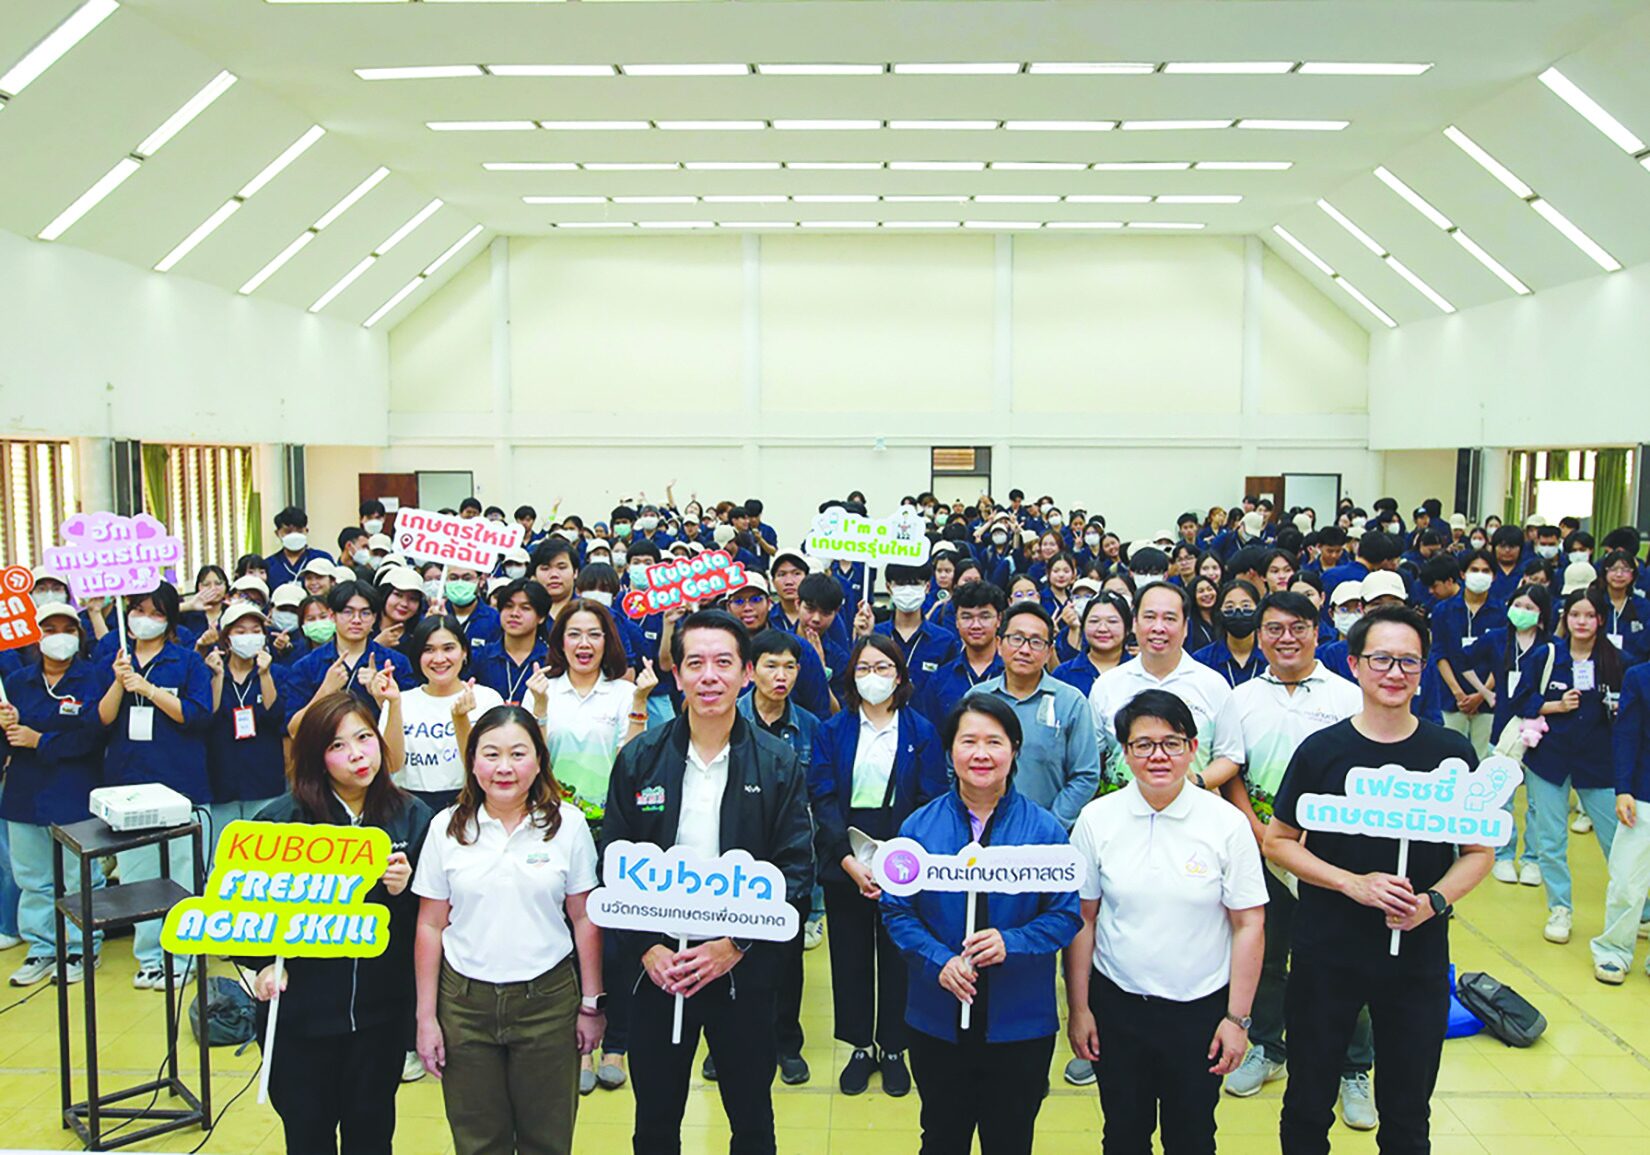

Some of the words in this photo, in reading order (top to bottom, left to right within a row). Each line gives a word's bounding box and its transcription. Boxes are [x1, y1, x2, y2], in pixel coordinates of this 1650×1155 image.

[401, 513, 518, 549] เกษตรใหม่
[843, 519, 871, 535] I'm
[877, 525, 887, 535] a
[50, 542, 178, 571] เกษตรไทย
[415, 533, 490, 565] ใกล้ฉัน
[812, 537, 922, 559] เกษตรรุ่นใหม่
[647, 587, 680, 609] for
[681, 575, 726, 598] Gen
[724, 565, 745, 585] Z
[649, 553, 729, 587] Kubota
[1355, 769, 1457, 803] เฟรชชี่
[1306, 803, 1500, 838] เกษตรนิวเจน
[228, 832, 374, 865] KUBOTA
[218, 869, 366, 904] FRESHY
[619, 856, 772, 900] Kubota
[927, 860, 1075, 882] คณะเกษตรศาสตร์
[176, 908, 278, 945] AGRI
[284, 912, 379, 945] SKILL
[601, 900, 786, 927] นวัตกรรมเกษตรเพื่ออนาคต
